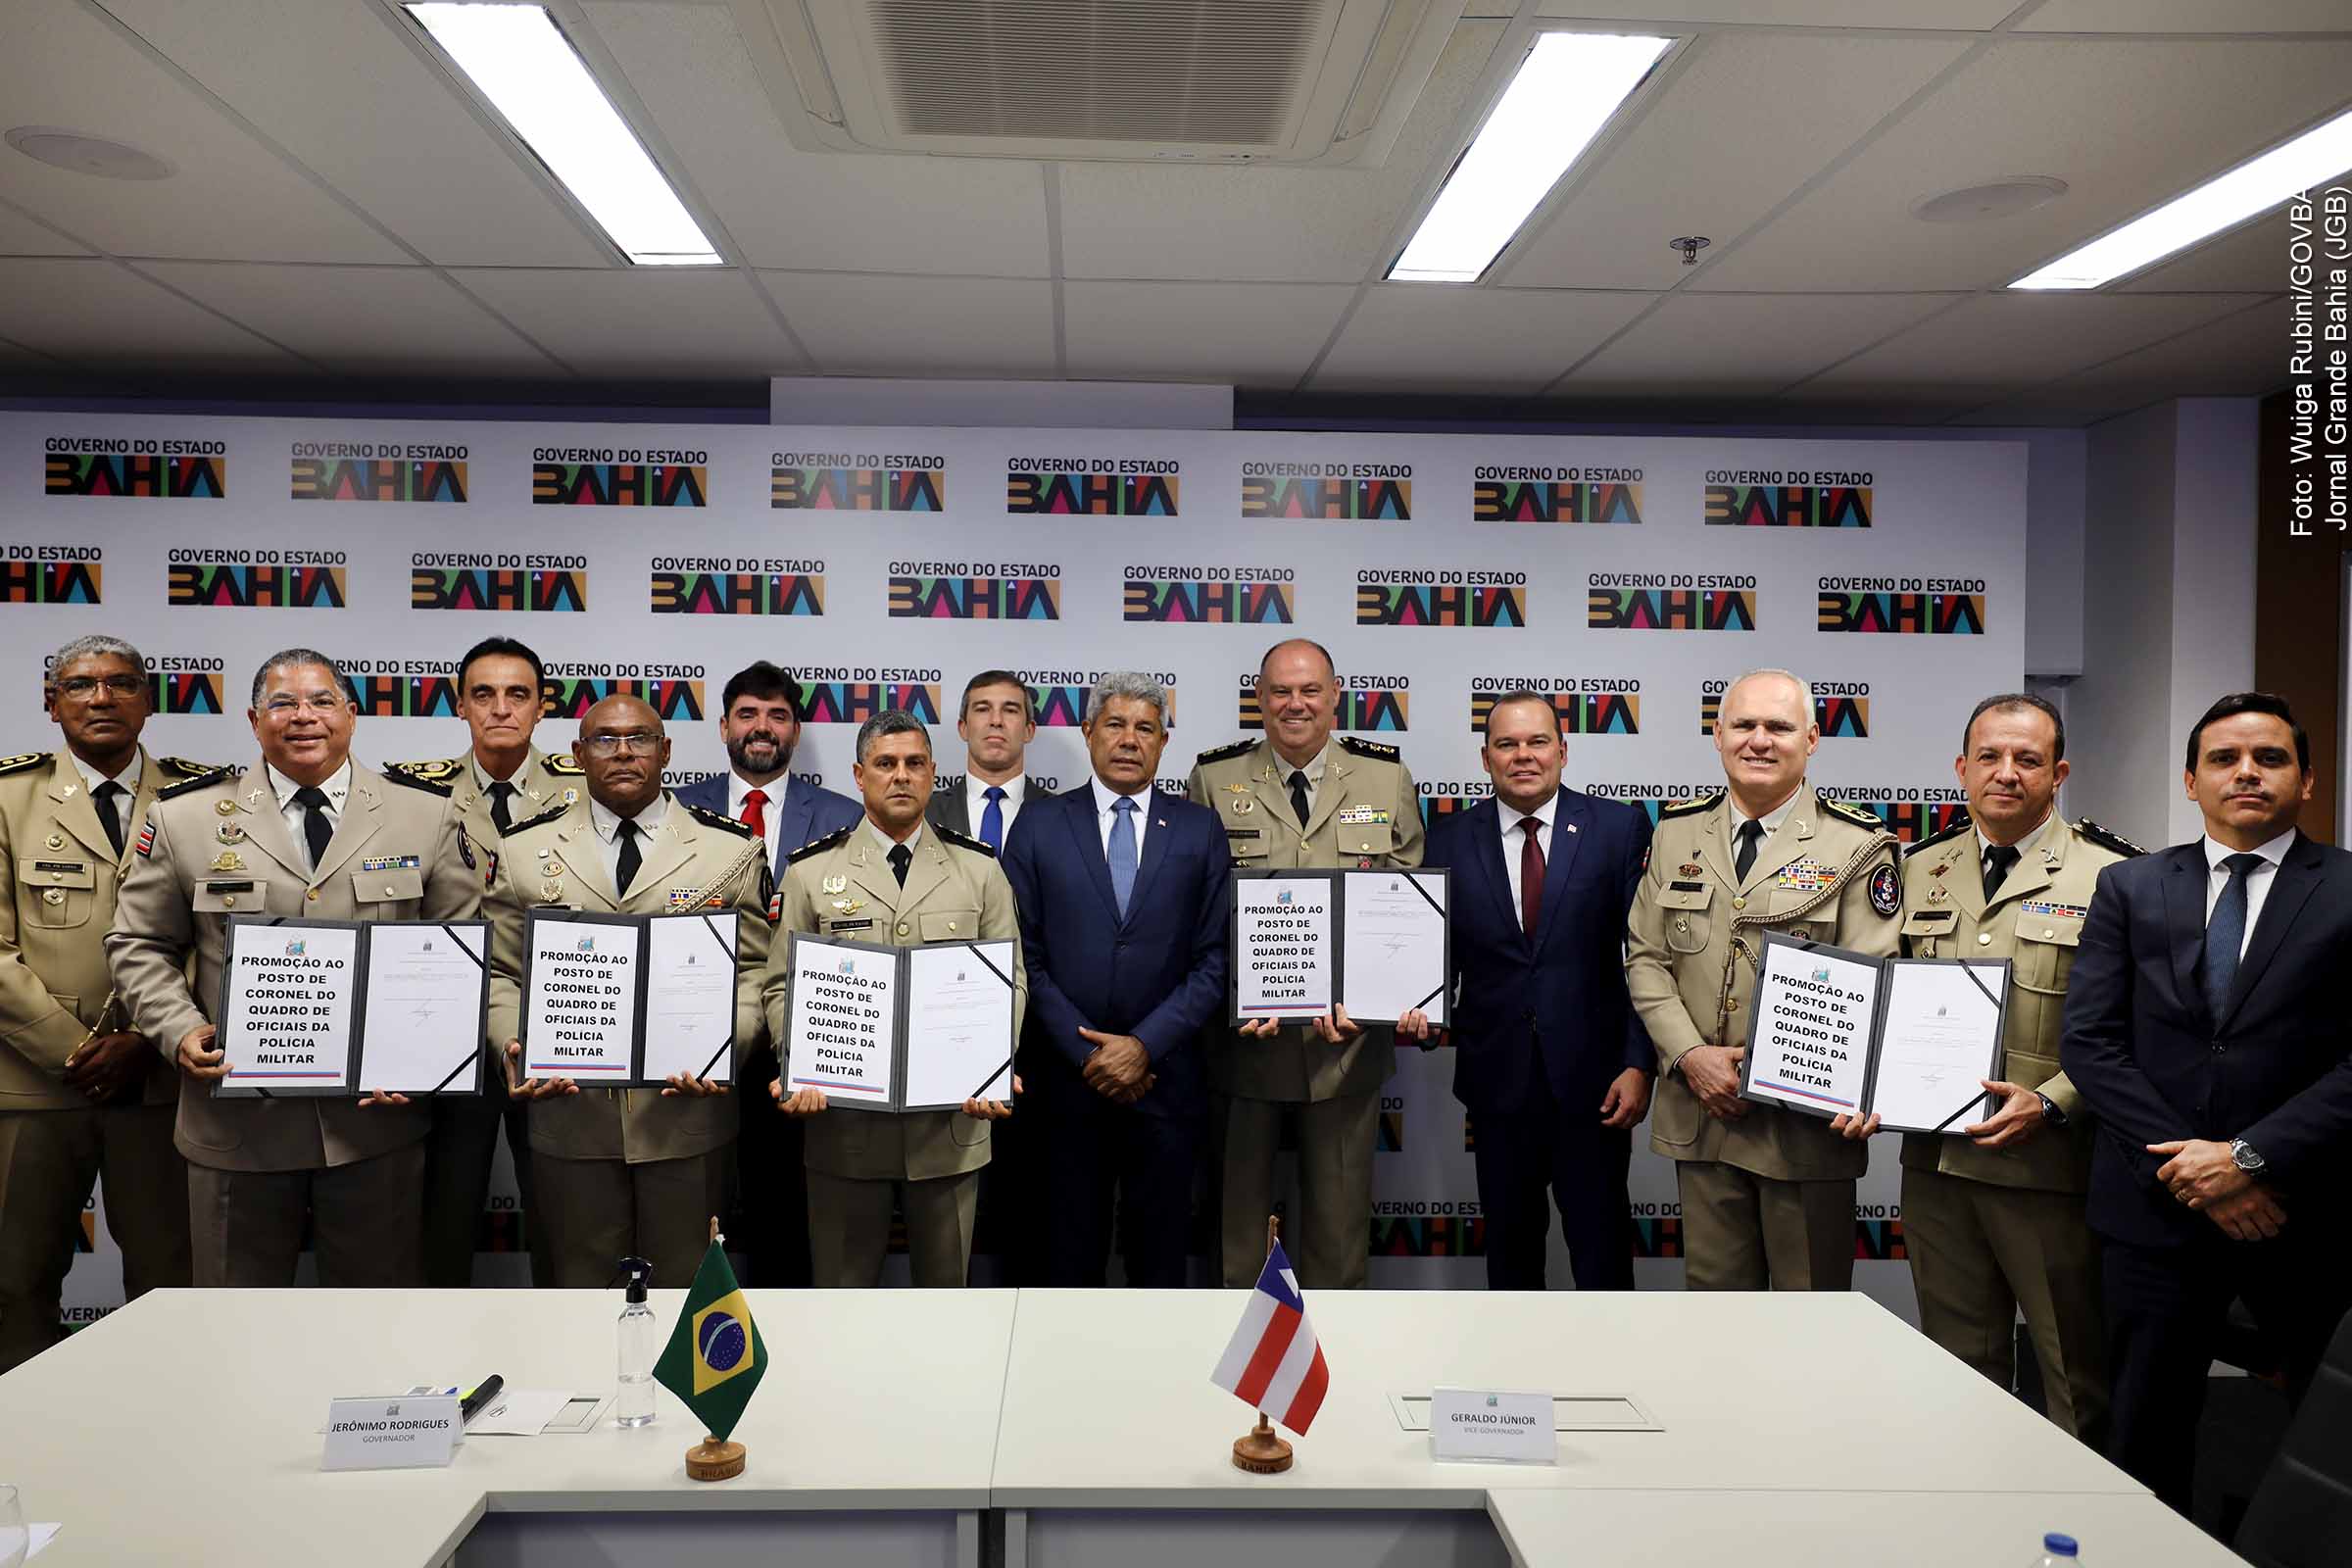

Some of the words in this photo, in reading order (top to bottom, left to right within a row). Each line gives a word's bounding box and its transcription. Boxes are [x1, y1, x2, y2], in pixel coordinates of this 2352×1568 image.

[45, 438, 129, 453] GOVERNO
[133, 439, 158, 454] DO
[163, 440, 225, 455] ESTADO
[292, 443, 373, 458] GOVERNO
[378, 444, 402, 459] DO
[407, 445, 468, 460] ESTADO
[533, 448, 613, 463] GOVERNO
[618, 449, 642, 464] DO
[647, 450, 708, 465] ESTADO
[772, 453, 851, 467] GOVERNO
[857, 454, 879, 468] DO
[884, 455, 944, 469] ESTADO
[1008, 458, 1087, 471] GOVERNO
[1092, 459, 1114, 472] DO
[1119, 460, 1179, 473] ESTADO
[1243, 463, 1320, 476] GOVERNO
[1326, 464, 1348, 477] DO
[1352, 465, 1412, 478] ESTADO
[45, 453, 225, 498] BAHIA
[291, 458, 467, 503] BAHIA
[1475, 466, 1552, 480] GOVERNO
[1557, 467, 1580, 481] DO
[1585, 468, 1642, 482] ESTADO
[1706, 470, 1783, 484] GOVERNO
[1788, 471, 1810, 485] DO
[1814, 472, 1874, 486] ESTADO
[533, 463, 708, 507] BAHIA
[771, 467, 944, 512] BAHIA
[1007, 473, 1178, 516] BAHIA
[1243, 477, 1411, 520] BAHIA
[1474, 481, 1642, 523] BAHIA
[1705, 485, 1873, 528] BAHIA
[9, 546, 32, 560] DO
[38, 547, 102, 561] ESTADO
[169, 549, 250, 563] GOVERNO
[256, 550, 279, 564] DO
[284, 551, 346, 564] ESTADO
[412, 552, 493, 567] GOVERNO
[497, 553, 520, 568] DO
[525, 554, 587, 569] ESTADO
[652, 557, 731, 570] GOVERNO
[737, 558, 760, 571] DO
[764, 559, 824, 572] ESTADO
[889, 562, 968, 575] GOVERNO
[973, 563, 996, 576] DO
[1001, 564, 1060, 577] ESTADO
[1124, 565, 1202, 579] GOVERNO
[1207, 566, 1230, 580] DO
[1235, 567, 1294, 581] ESTADO
[1357, 569, 1435, 583] GOVERNO
[1440, 570, 1462, 584] DO
[1467, 571, 1526, 585] ESTADO
[1589, 573, 1666, 586] GOVERNO
[1671, 574, 1692, 587] DO
[1698, 575, 1756, 588] ESTADO
[169, 564, 345, 608] BAHIA
[412, 568, 586, 612] BAHIA
[1819, 577, 1895, 591] GOVERNO
[1900, 578, 1922, 592] DO
[1927, 579, 1985, 593] ESTADO
[651, 572, 823, 616] BAHIA
[889, 576, 1060, 620] BAHIA
[1123, 581, 1294, 624] BAHIA
[1356, 585, 1526, 627] BAHIA
[1589, 588, 1756, 631] BAHIA
[1818, 592, 1984, 635] BAHIA
[616, 664, 639, 677] DO
[645, 664, 705, 678] ESTADO
[854, 668, 876, 681] DO
[882, 668, 941, 682] ESTADO
[1472, 677, 1549, 692] GOVERNO
[1554, 679, 1576, 692] DO
[1582, 679, 1640, 693] ESTADO
[1811, 682, 1869, 696] ESTADO
[1815, 787, 1891, 801] GOVERNO
[1897, 788, 1919, 801] DO
[555, 968, 594, 978] POSTO
[597, 970, 612, 979] DE
[1252, 961, 1298, 970] OFICIAIS
[258, 974, 305, 983] POSTO
[309, 975, 326, 984] DE
[870, 981, 887, 990] AO
[246, 989, 313, 999] CORONEL
[317, 991, 336, 1000] DO
[544, 983, 601, 994] CORONEL
[816, 988, 855, 1000] POSTO
[858, 994, 872, 1003] DE
[547, 1000, 598, 1009] QUADRO
[1786, 993, 1827, 1008] POSTO
[1831, 1004, 1847, 1013] DE
[1846, 993, 1865, 1003] AO
[249, 1005, 309, 1015] QUADRO
[807, 1001, 860, 1015] CORONEL
[863, 1009, 880, 1018] DO
[545, 1015, 597, 1025] OFICIAIS
[809, 1016, 858, 1030] QUADRO
[860, 1024, 875, 1033] DE
[1774, 1005, 1833, 1026] CORONEL
[1837, 1020, 1855, 1031] DO
[247, 1022, 308, 1031] OFICIAIS
[1776, 1021, 1829, 1040] QUADRO
[1832, 1035, 1849, 1045] DE
[808, 1032, 857, 1046] OFICIAIS
[859, 1039, 876, 1048] DA
[1773, 1036, 1827, 1055] OFICIAIS
[1830, 1050, 1847, 1060] DA
[258, 1054, 315, 1063] MILITAR
[555, 1048, 604, 1056] MILITAR
[816, 1064, 863, 1077] MILITAR
[1780, 1069, 1832, 1088] MILITAR
[331, 1419, 386, 1433] JERÔNIMO
[389, 1419, 450, 1431] RODRIGUES
[1451, 1413, 1497, 1424] GERALDO
[362, 1434, 416, 1444] GOVERNADOR
